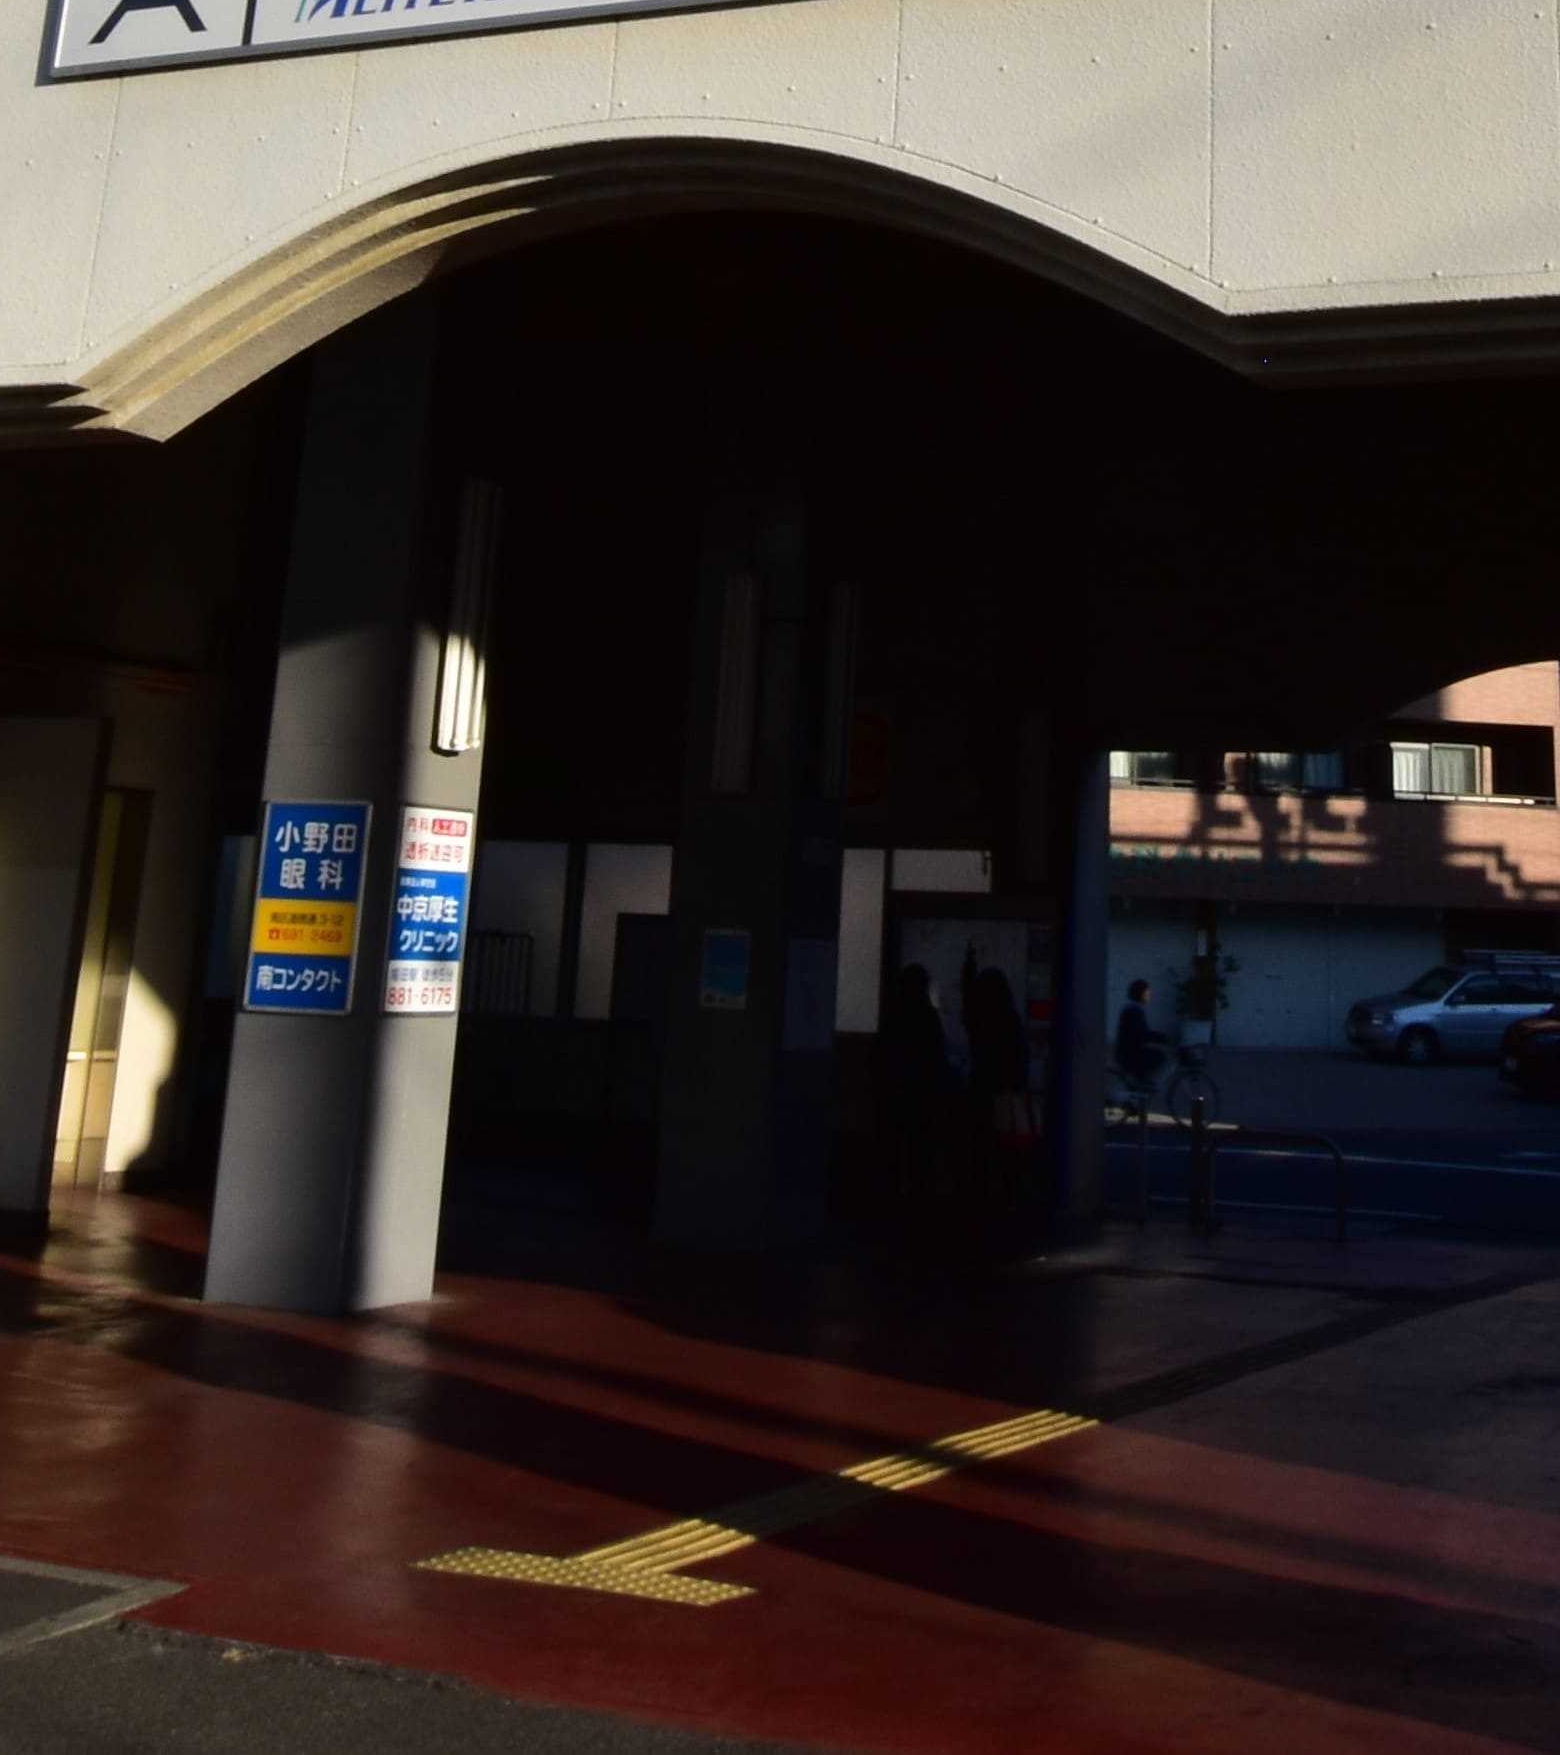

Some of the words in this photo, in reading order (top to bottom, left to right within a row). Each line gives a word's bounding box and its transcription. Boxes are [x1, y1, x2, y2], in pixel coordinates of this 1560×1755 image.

[275, 821, 358, 854] 小野田
[279, 858, 345, 890] 眼科
[396, 895, 459, 923] 中京厚生
[399, 930, 459, 953] クリニック
[256, 965, 343, 992] 南コンタクト
